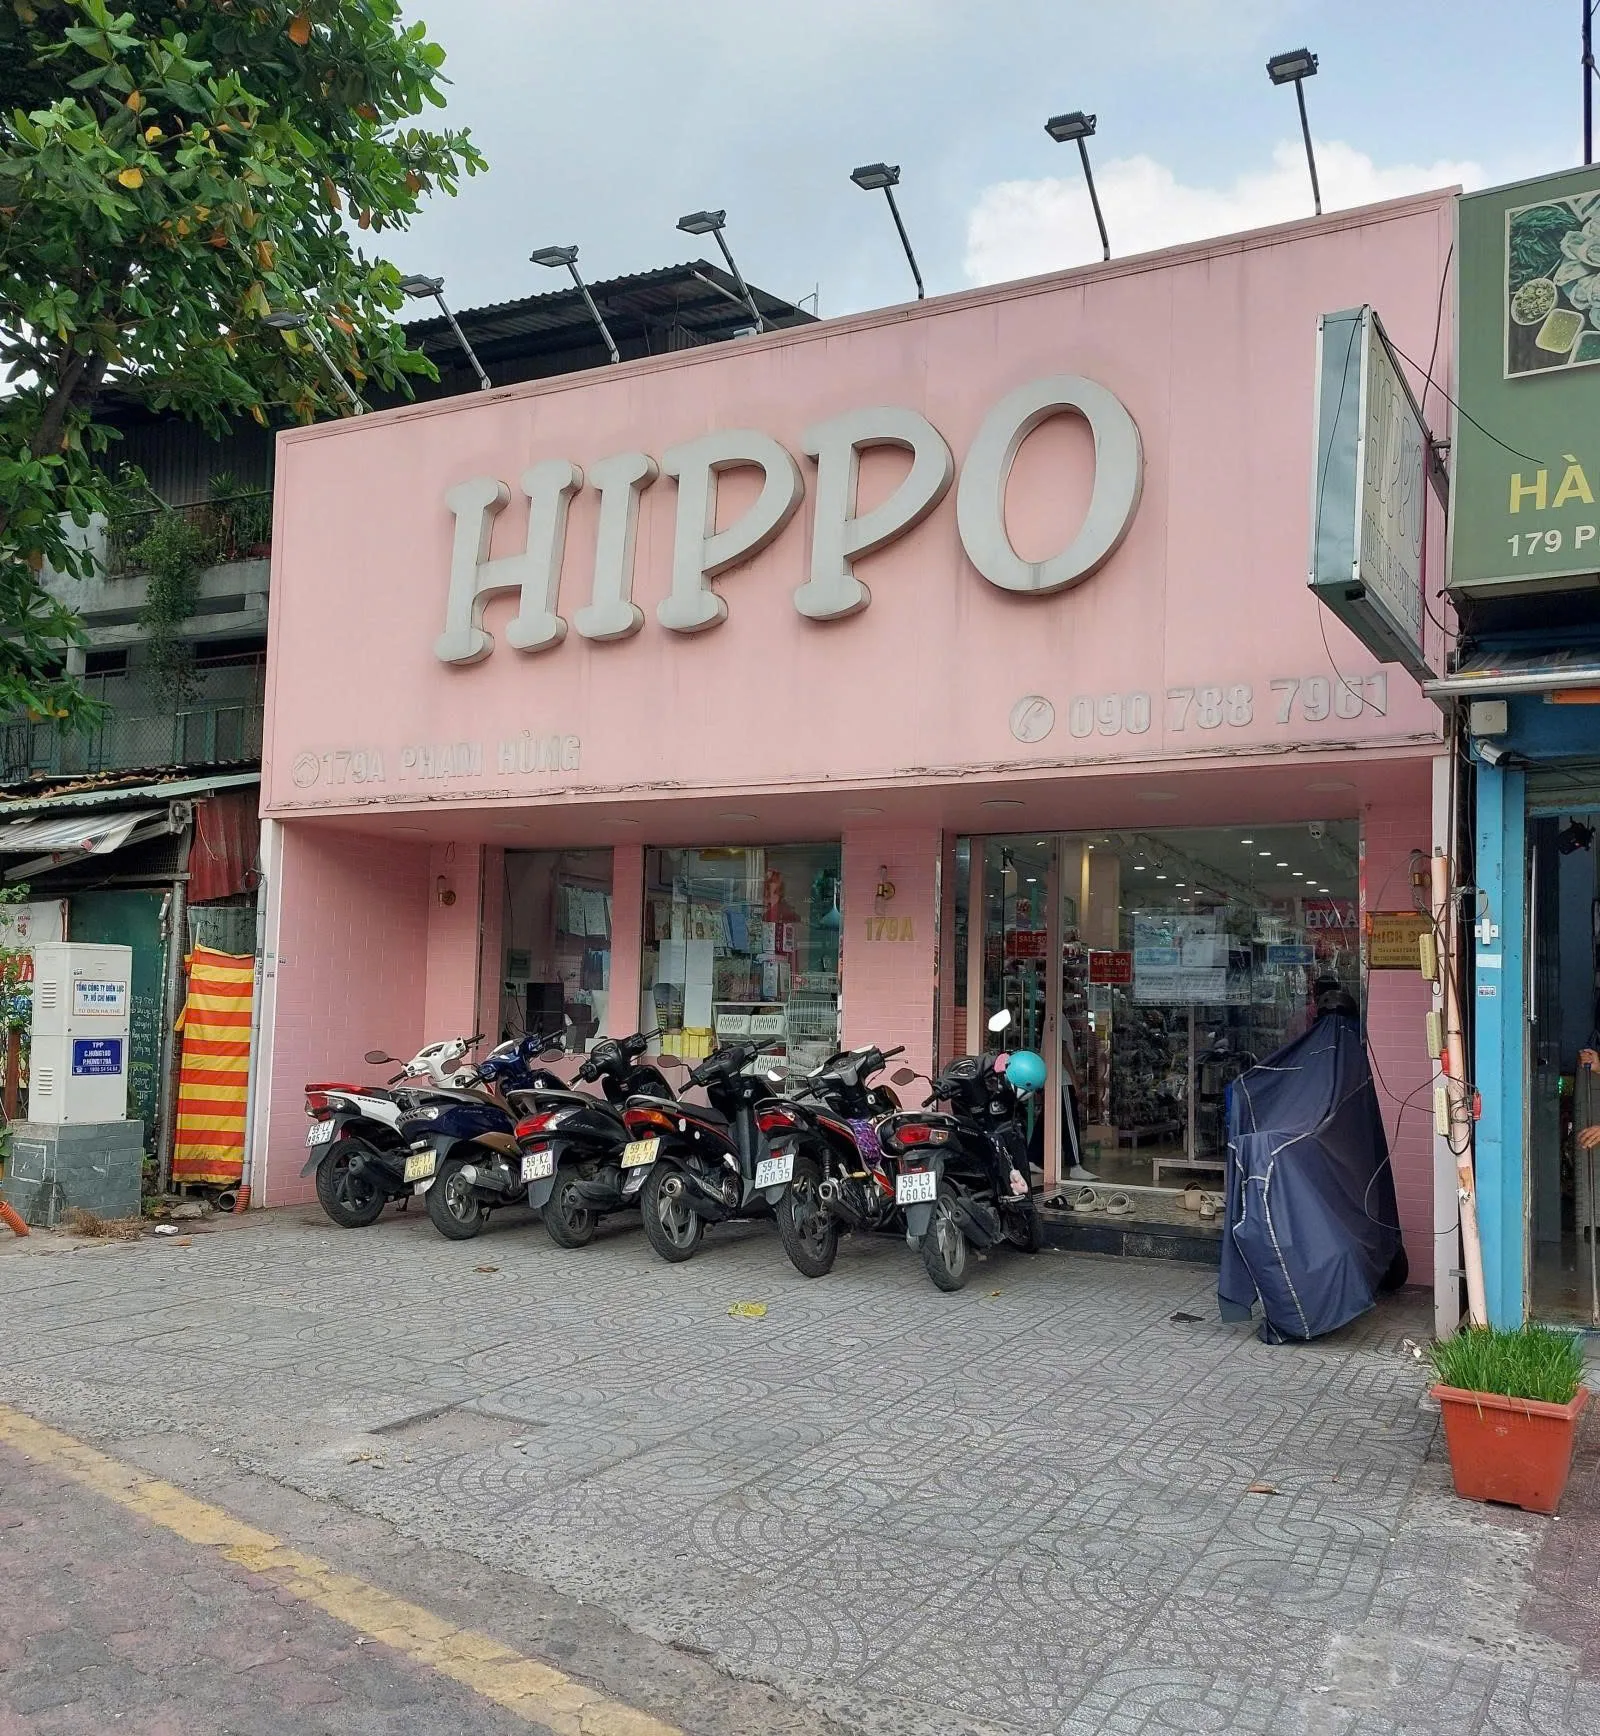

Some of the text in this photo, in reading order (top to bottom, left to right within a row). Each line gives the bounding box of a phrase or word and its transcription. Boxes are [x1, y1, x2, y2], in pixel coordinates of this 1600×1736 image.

[1509, 454, 1595, 514] HÀ
[434, 374, 1145, 664] HIPPO
[1507, 525, 1600, 556] 179 P
[1069, 671, 1387, 738] 090 788 7961
[321, 729, 580, 787] 179A PHẠM HÙNG
[864, 917, 915, 941] 179A
[1093, 957, 1113, 966] SALE
[105, 994, 117, 1002] MINH
[526, 1152, 549, 1168] 59-K2
[761, 1157, 787, 1173] 59-E1
[757, 1168, 790, 1186] 360.35
[902, 1173, 931, 1189] 59-L3
[900, 1186, 933, 1202] 460.64
